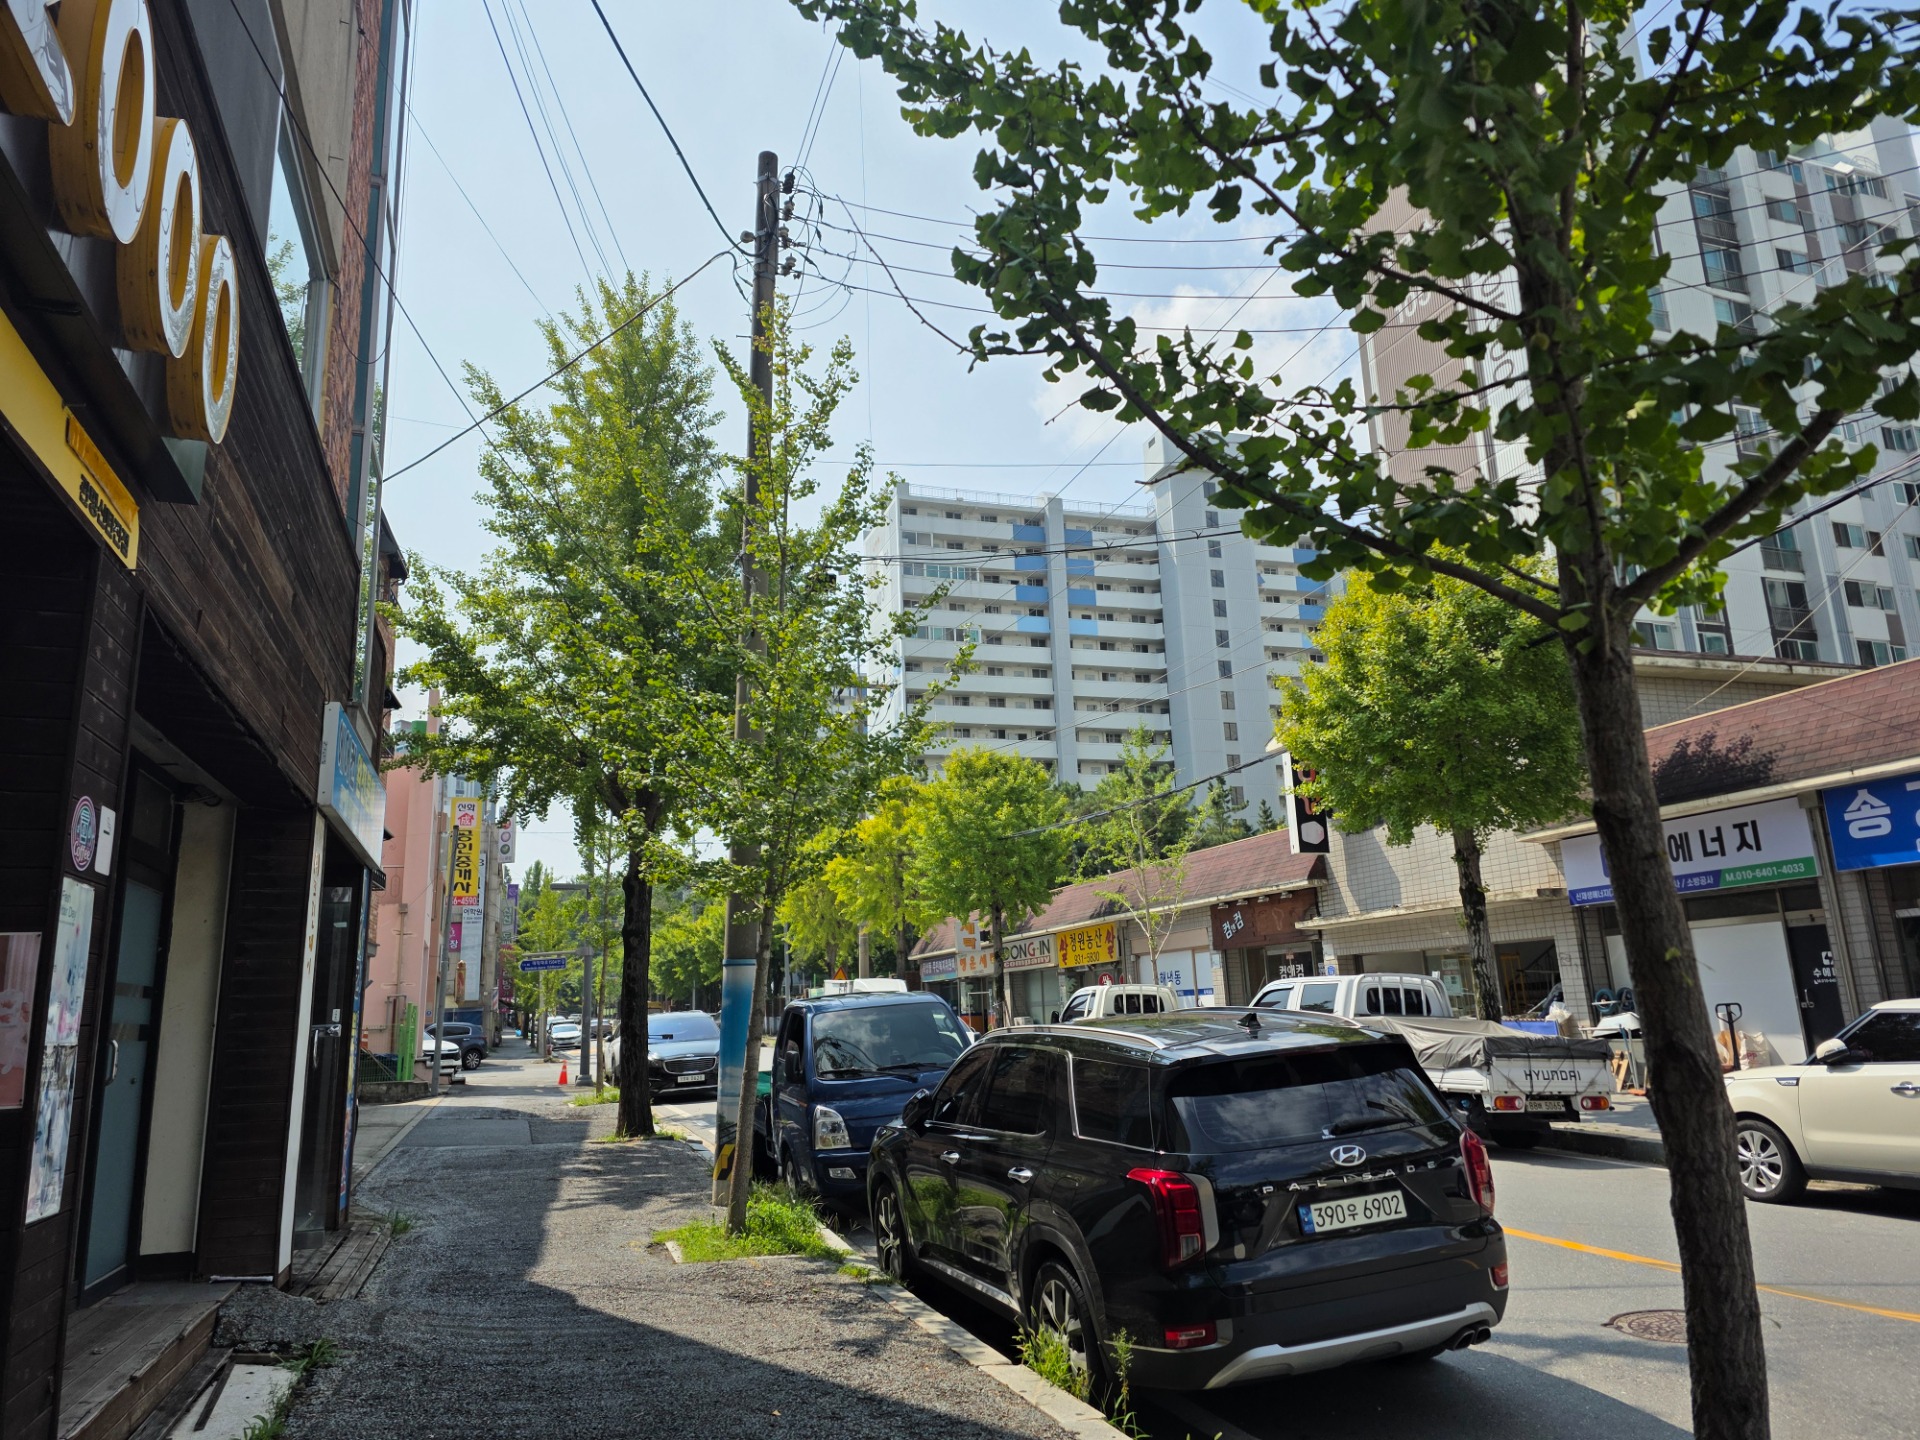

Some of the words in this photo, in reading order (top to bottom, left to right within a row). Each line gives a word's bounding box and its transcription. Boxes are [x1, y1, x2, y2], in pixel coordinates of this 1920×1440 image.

[457, 803, 476, 812] 신화
[74, 841, 91, 862] Coffee
[453, 829, 474, 894] 공인중개사
[1686, 875, 1714, 888] 소방공사
[1725, 862, 1805, 882] M.010-6401-4033
[1069, 927, 1103, 952] 청원농산
[1003, 955, 1051, 968] company
[1074, 951, 1100, 965] 931-5830
[1523, 1069, 1582, 1081] HYUNDAI
[1262, 1160, 1438, 1194] PALISADE
[1314, 1202, 1359, 1228] 390우
[1363, 1194, 1402, 1220] 6902
